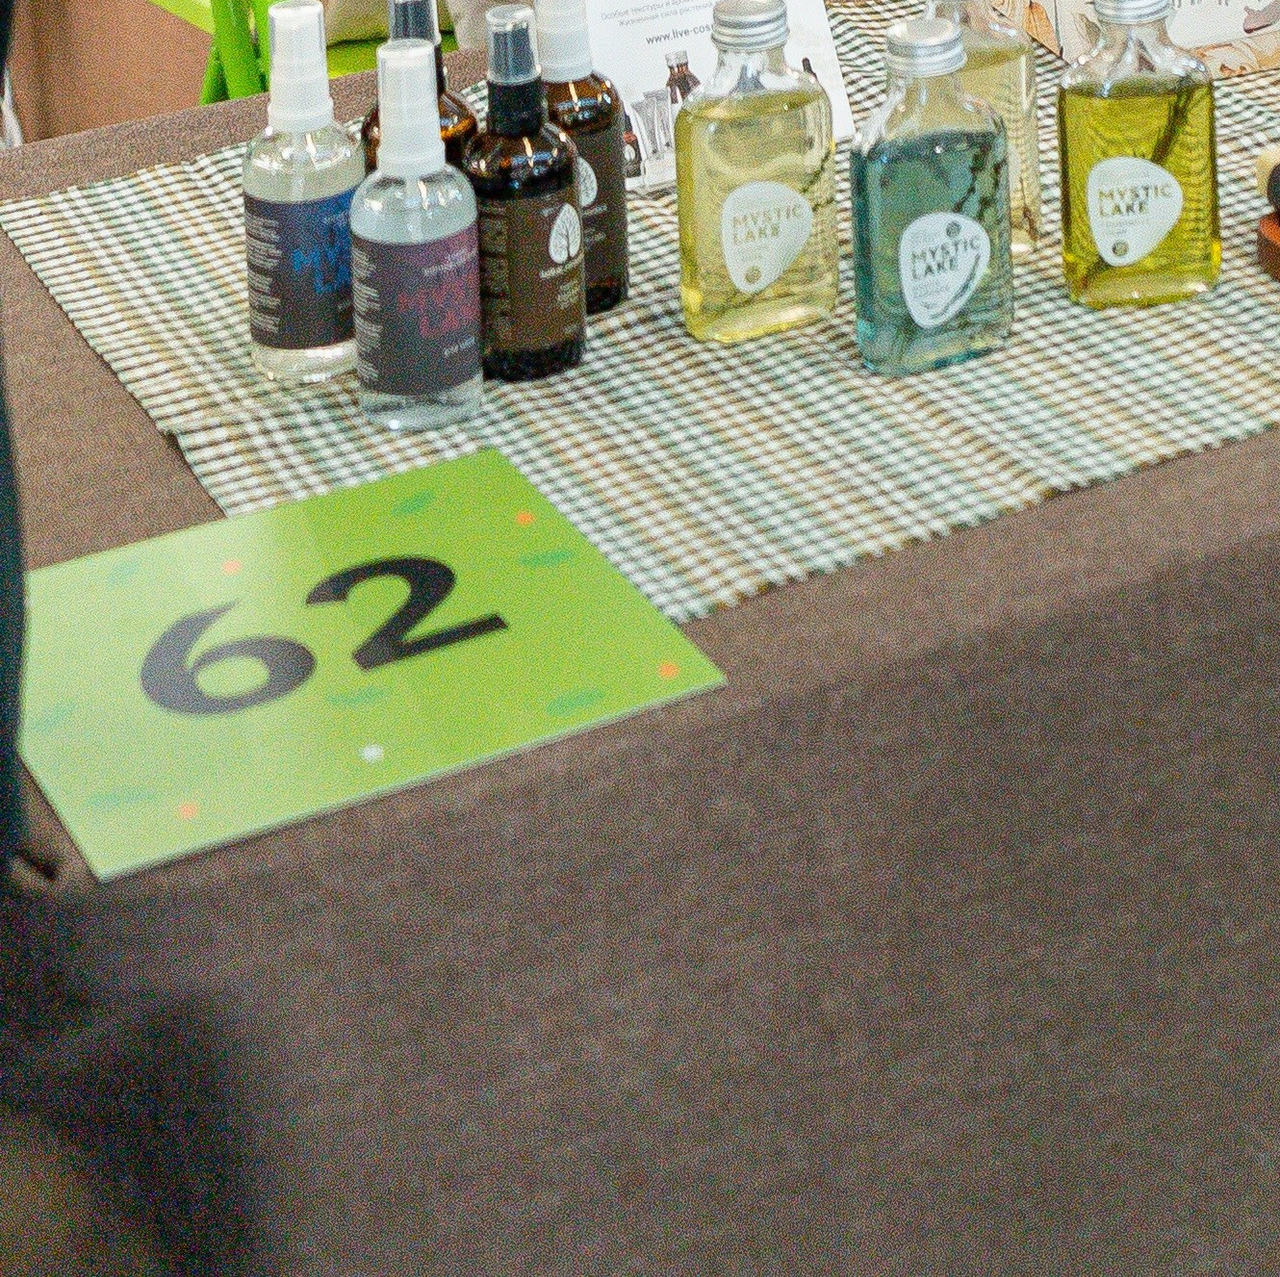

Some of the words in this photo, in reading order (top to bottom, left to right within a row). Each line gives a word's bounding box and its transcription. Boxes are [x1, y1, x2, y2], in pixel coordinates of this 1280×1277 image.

[1098, 183, 1173, 202] MYSTIC
[731, 203, 803, 229] MYSTIC
[1099, 200, 1149, 218] LAKE
[732, 222, 781, 246] LAKE
[911, 236, 981, 264] MYSTIC
[911, 256, 959, 280] LAKE
[139, 553, 510, 717] 62
